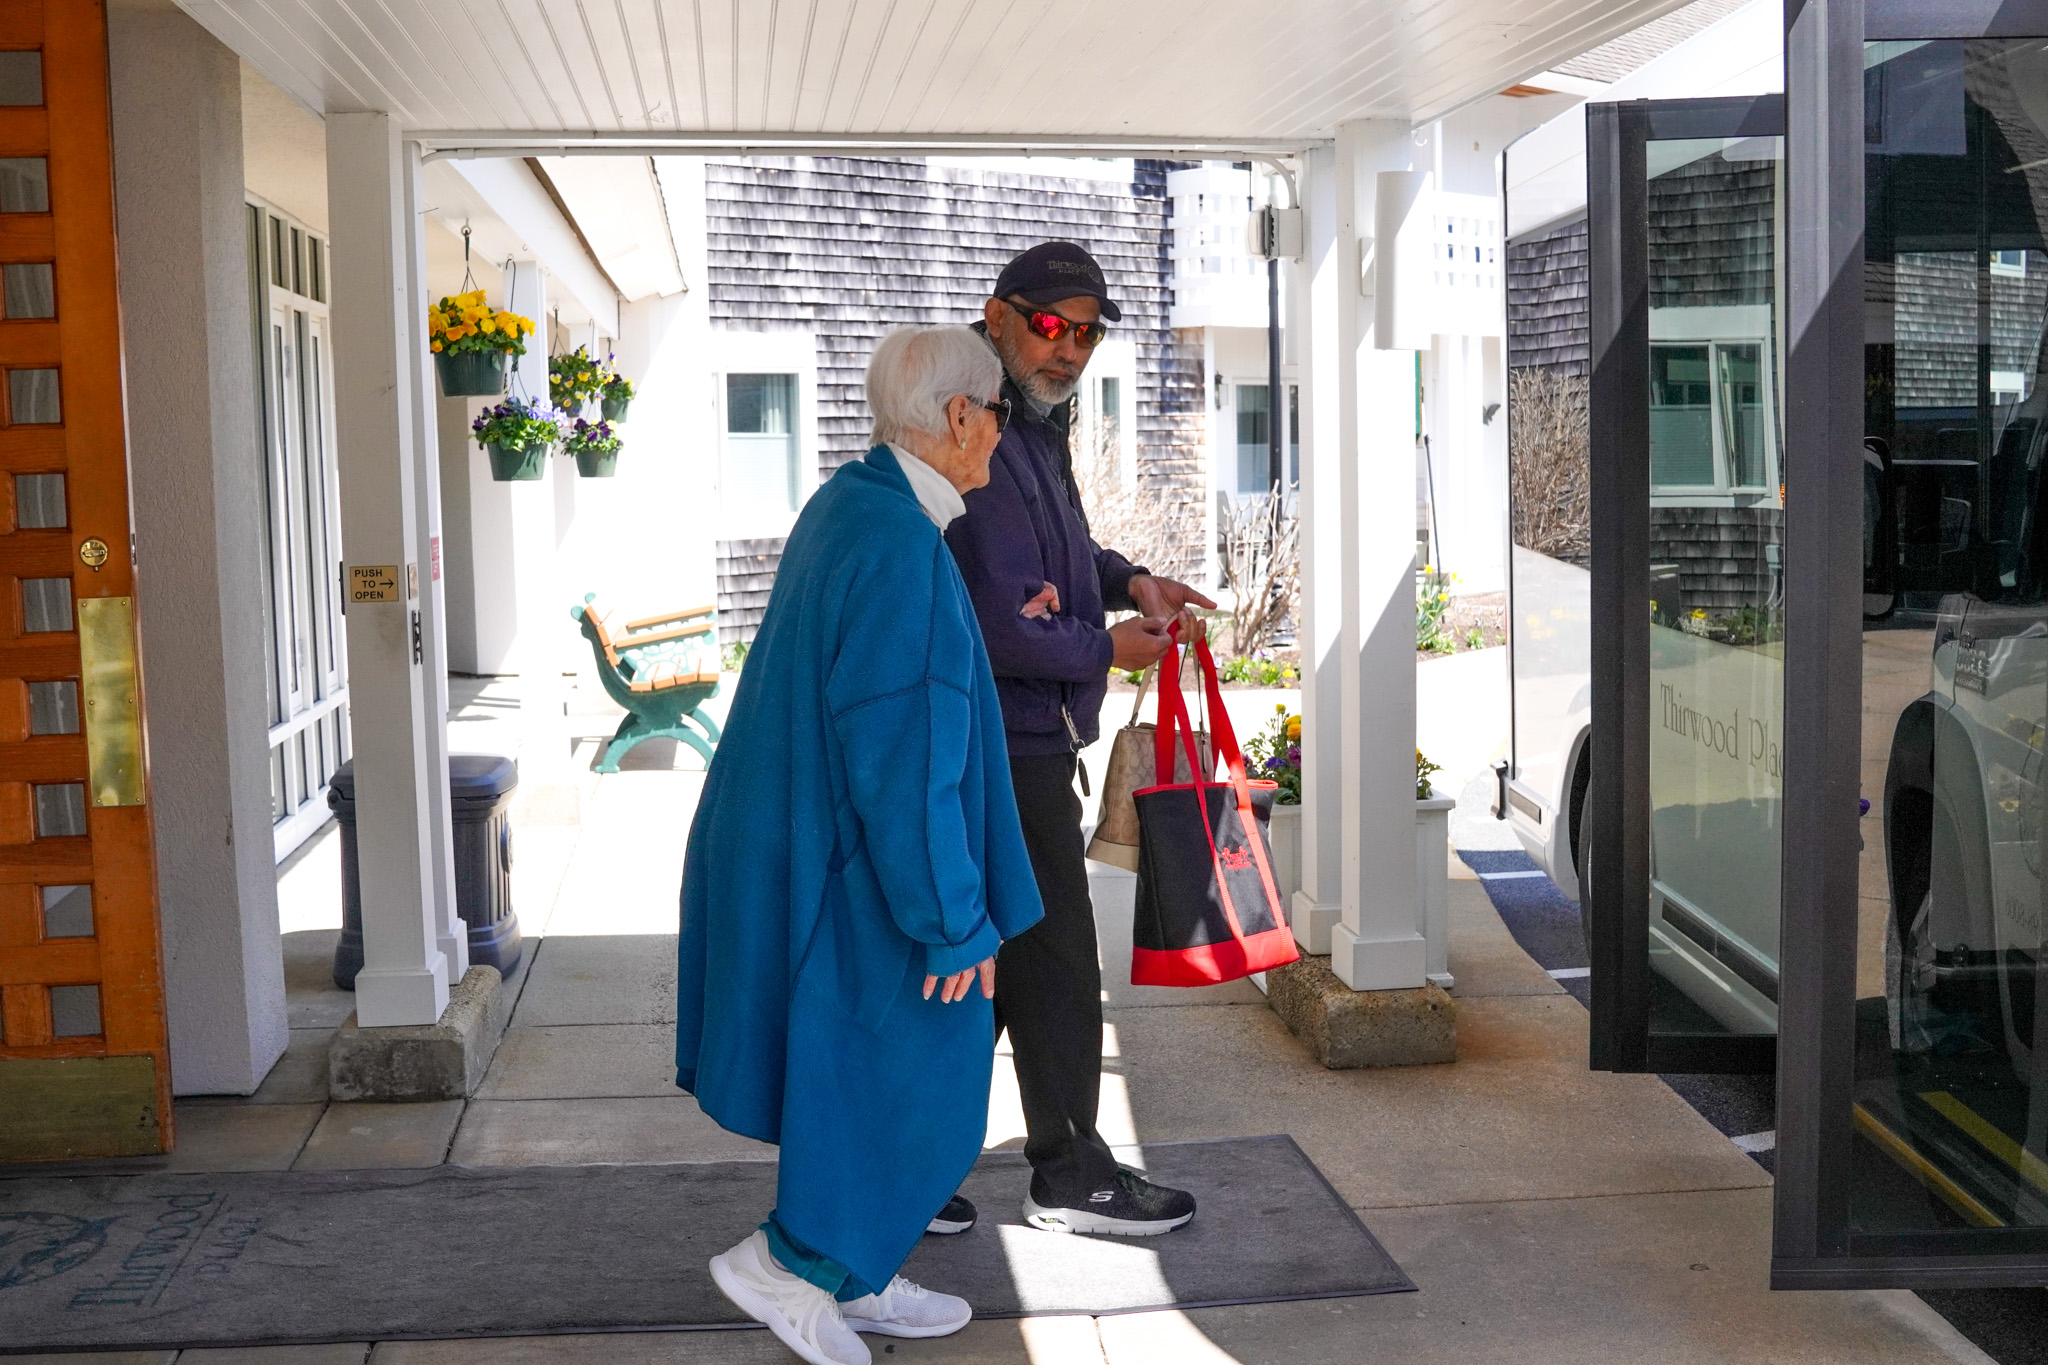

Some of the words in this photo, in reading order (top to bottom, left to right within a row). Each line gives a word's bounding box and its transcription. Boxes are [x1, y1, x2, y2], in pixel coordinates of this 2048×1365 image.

[1047, 260, 1087, 273] Thirwood
[354, 569, 383, 578] PUSH
[362, 580, 376, 589] TO
[355, 591, 384, 600] OPEN
[1661, 681, 1739, 760] Thirwood
[63, 1191, 216, 1312] Thirwood
